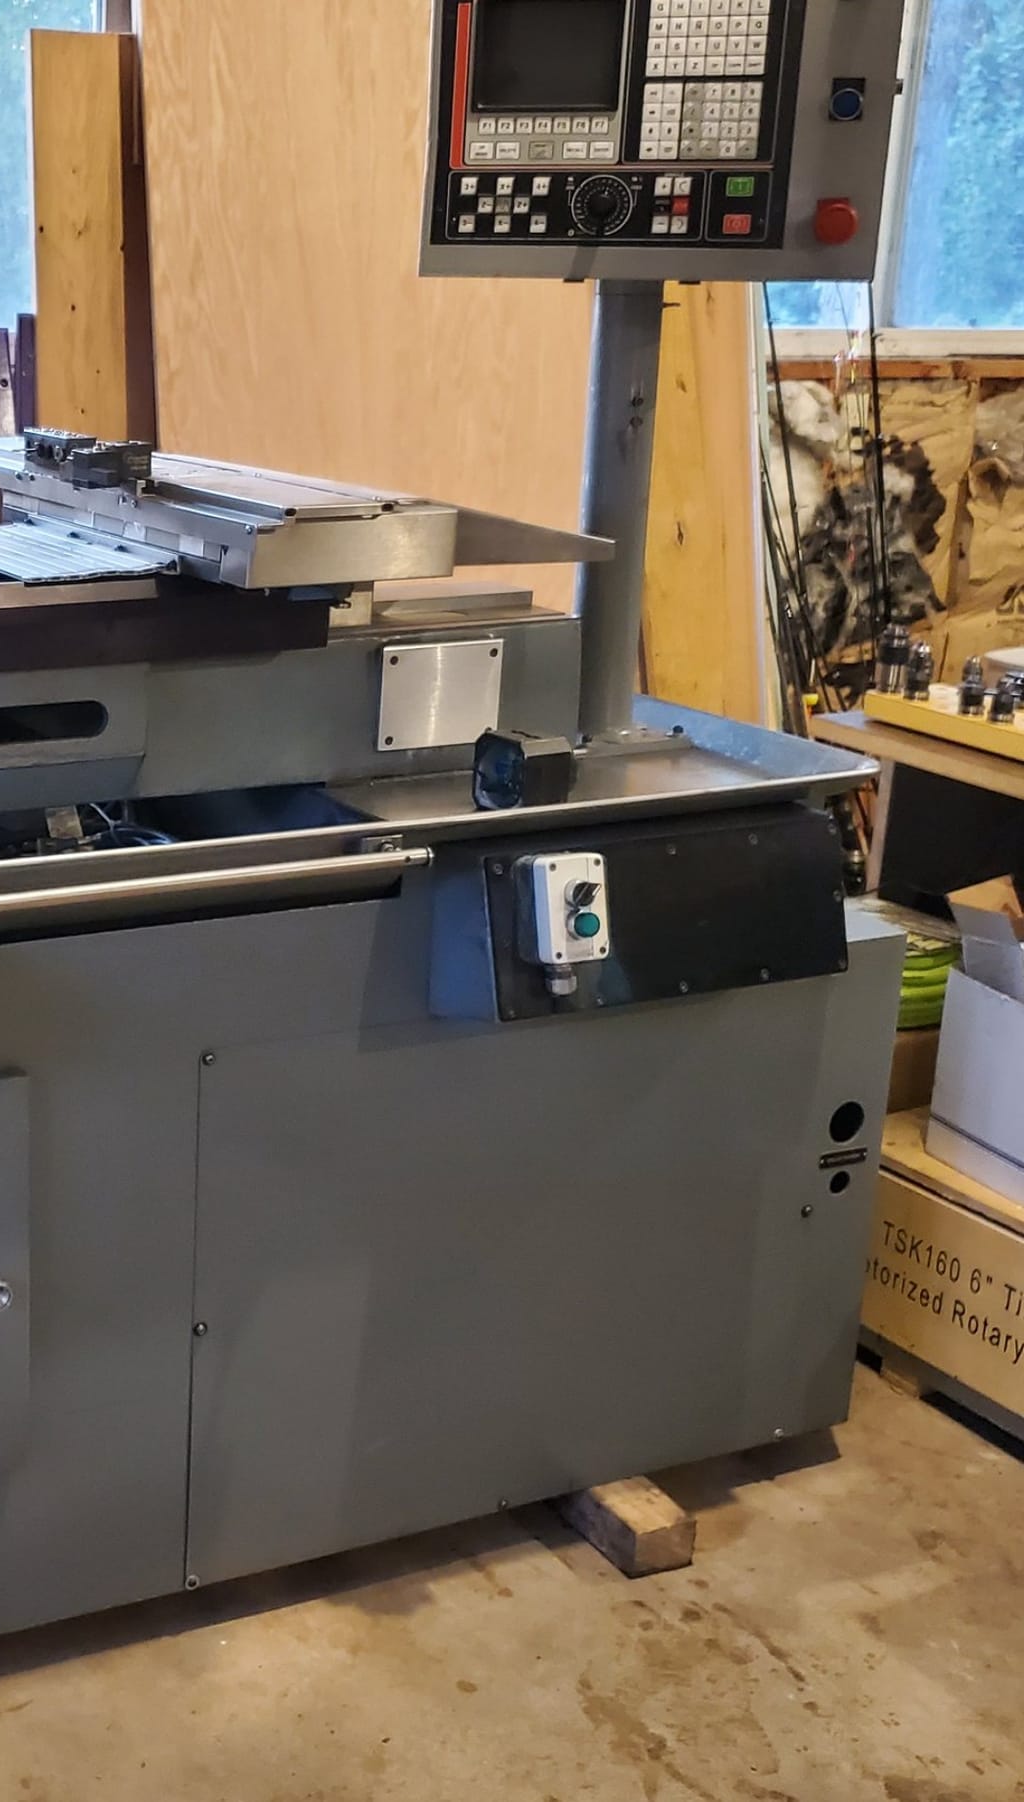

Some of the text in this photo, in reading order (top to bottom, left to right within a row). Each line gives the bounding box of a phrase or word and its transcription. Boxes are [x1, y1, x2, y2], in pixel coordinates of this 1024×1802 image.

[883, 1220, 961, 1283] TSK160
[970, 1268, 993, 1294] 6"
[952, 1299, 1024, 1365] Rotary
